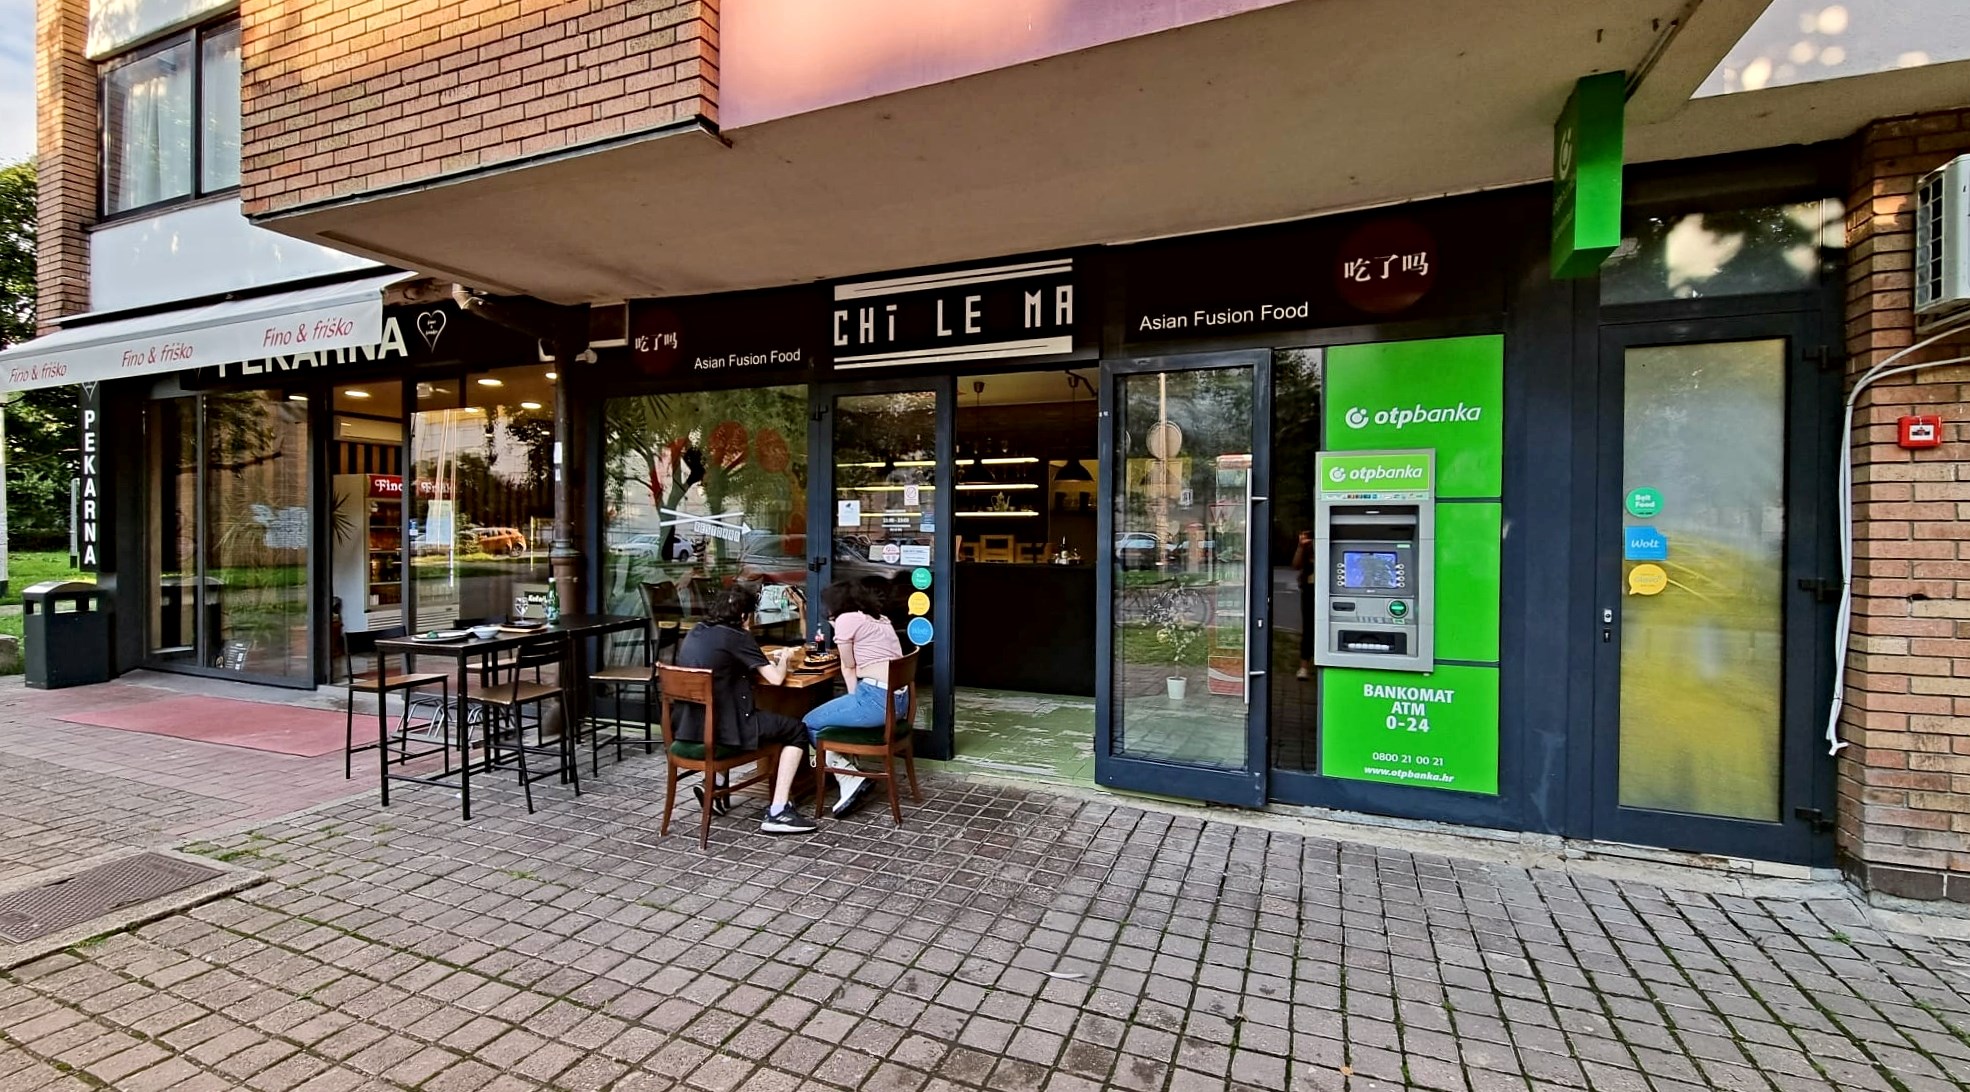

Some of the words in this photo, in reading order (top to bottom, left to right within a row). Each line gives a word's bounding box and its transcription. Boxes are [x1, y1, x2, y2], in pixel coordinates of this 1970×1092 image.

[1343, 251, 1430, 282] 吃了吗
[937, 295, 982, 337] LE
[1024, 284, 1073, 328] MA
[1139, 314, 1188, 331] Asian
[1194, 307, 1254, 327] Fusion
[1261, 301, 1309, 321] Food
[262, 327, 292, 348] Fino
[296, 323, 308, 342] &
[312, 317, 354, 341] friško
[635, 332, 678, 352] 吃了吗
[121, 349, 145, 367] Fino
[148, 346, 156, 364] &
[160, 342, 194, 363] friško
[694, 357, 725, 370] Asian
[729, 353, 767, 367] Fusion
[770, 348, 801, 363] Food
[9, 368, 29, 384] Fino
[31, 364, 38, 381] &
[1374, 402, 1482, 429] otpbanka
[1349, 464, 1423, 483] otpbanka
[83, 409, 97, 565] PEKARNA
[1631, 539, 1660, 549] Wolt
[1363, 684, 1455, 703] BANKOMAT
[1391, 701, 1426, 716] ATM
[1372, 752, 1398, 762] 0800
[1401, 754, 1412, 764] 21
[1416, 756, 1430, 765] 00
[1433, 757, 1444, 766] 21
[1364, 767, 1455, 783] www.otpbanka.hr
